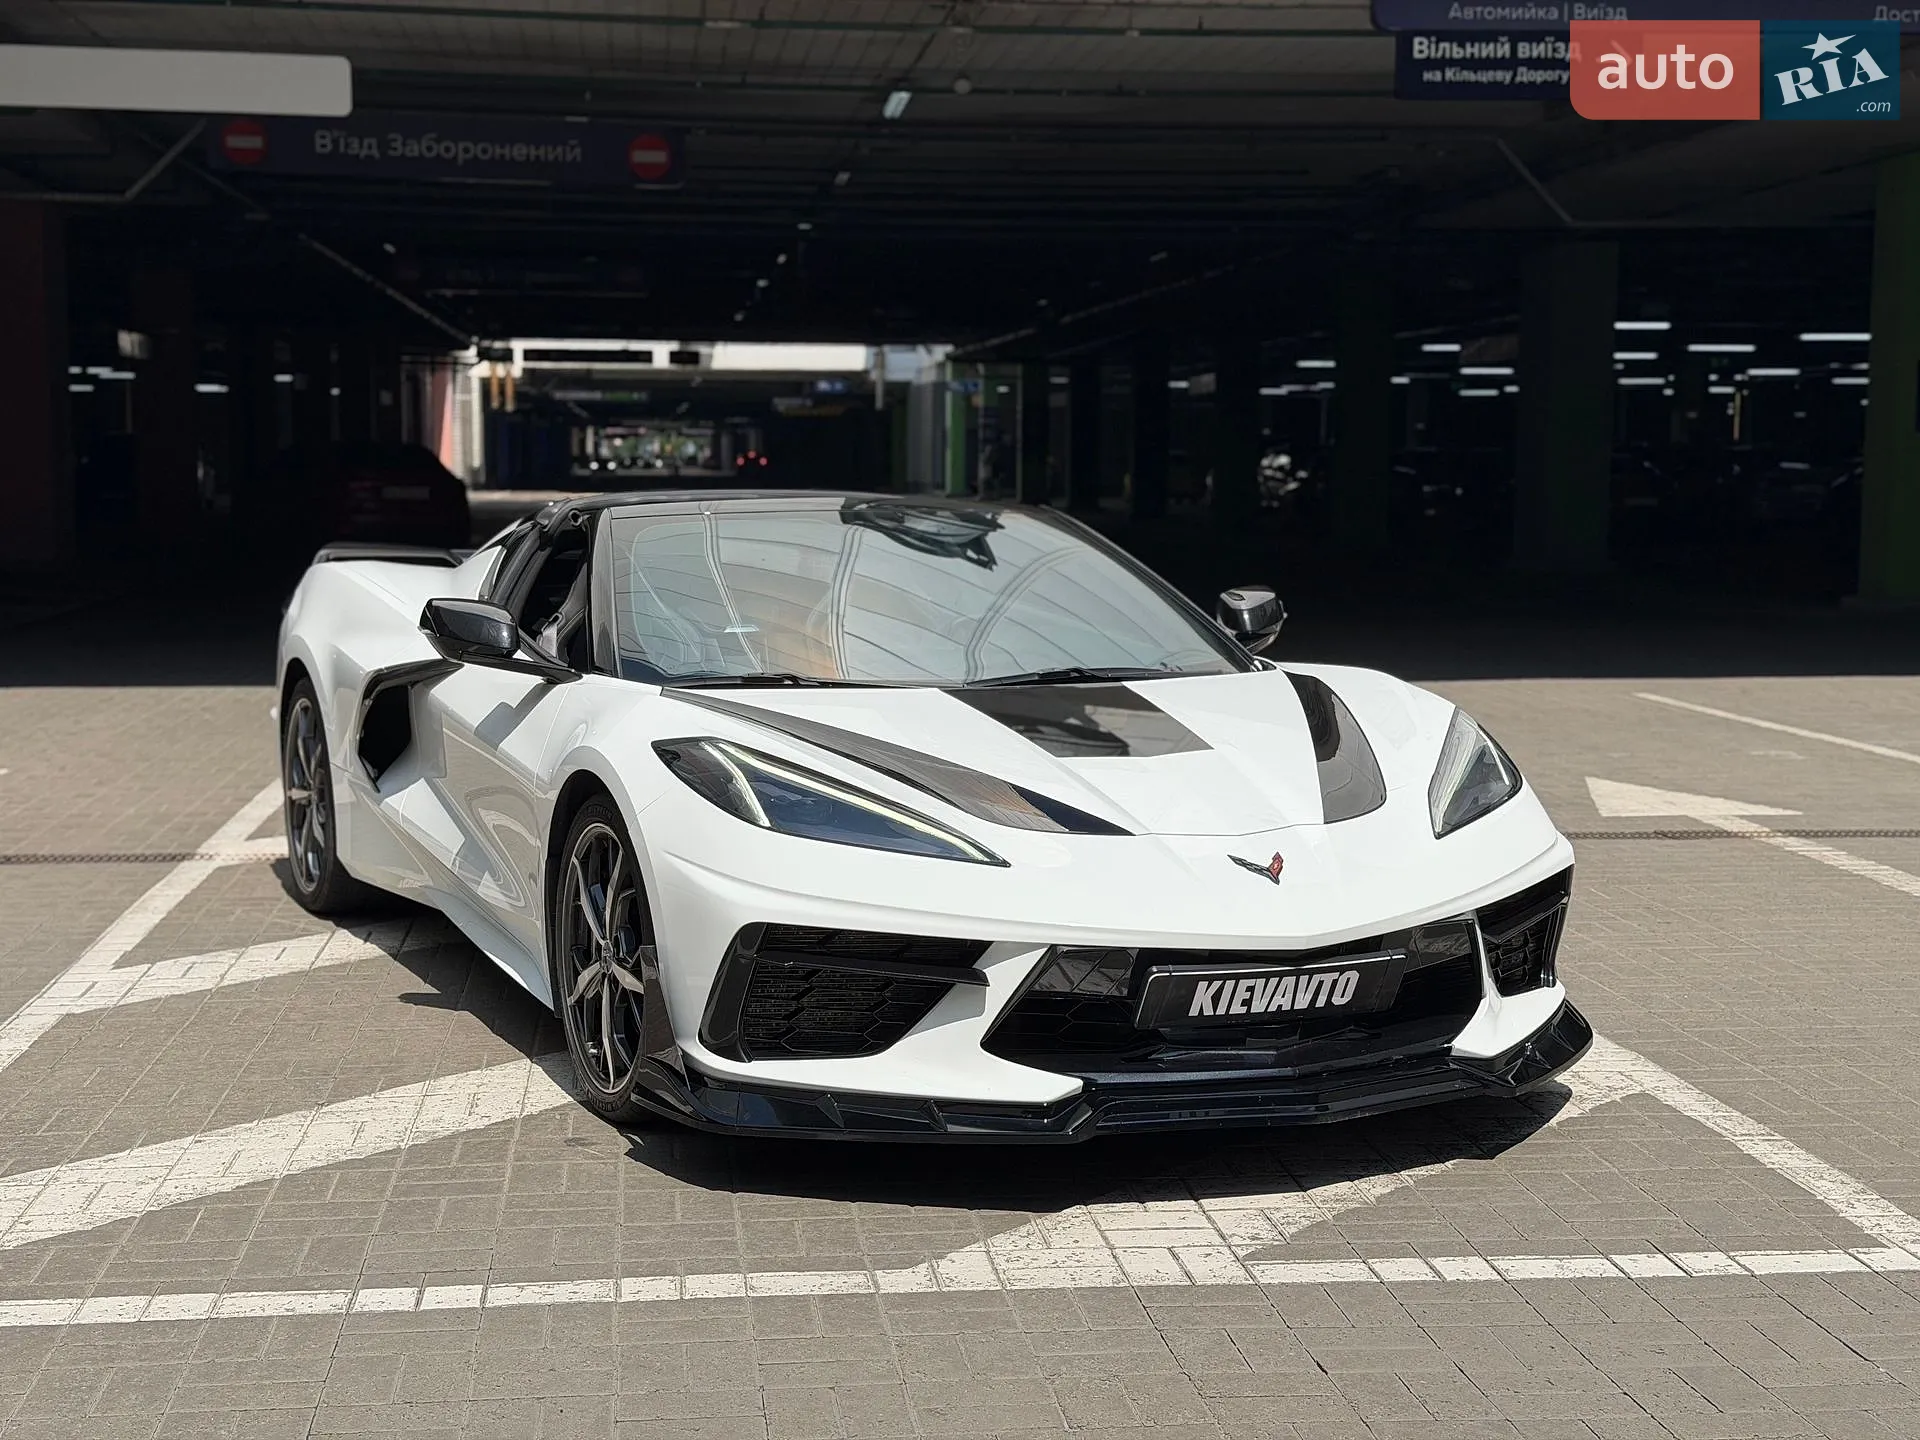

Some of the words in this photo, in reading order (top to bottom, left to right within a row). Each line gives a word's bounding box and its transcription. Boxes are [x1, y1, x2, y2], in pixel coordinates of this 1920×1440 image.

[1448, 3, 1559, 20] Автомийка
[1573, 3, 1628, 23] Виїзд
[1412, 36, 1510, 59] Вільний
[1517, 37, 1582, 62] виїзд
[1423, 71, 1442, 82] на
[1444, 68, 1512, 85] Кільцеву
[1515, 69, 1570, 85] Дорогу
[314, 129, 381, 159] В'їзд
[387, 133, 581, 166] Заборонений
[1188, 970, 1360, 1017] KIEVAVTO
